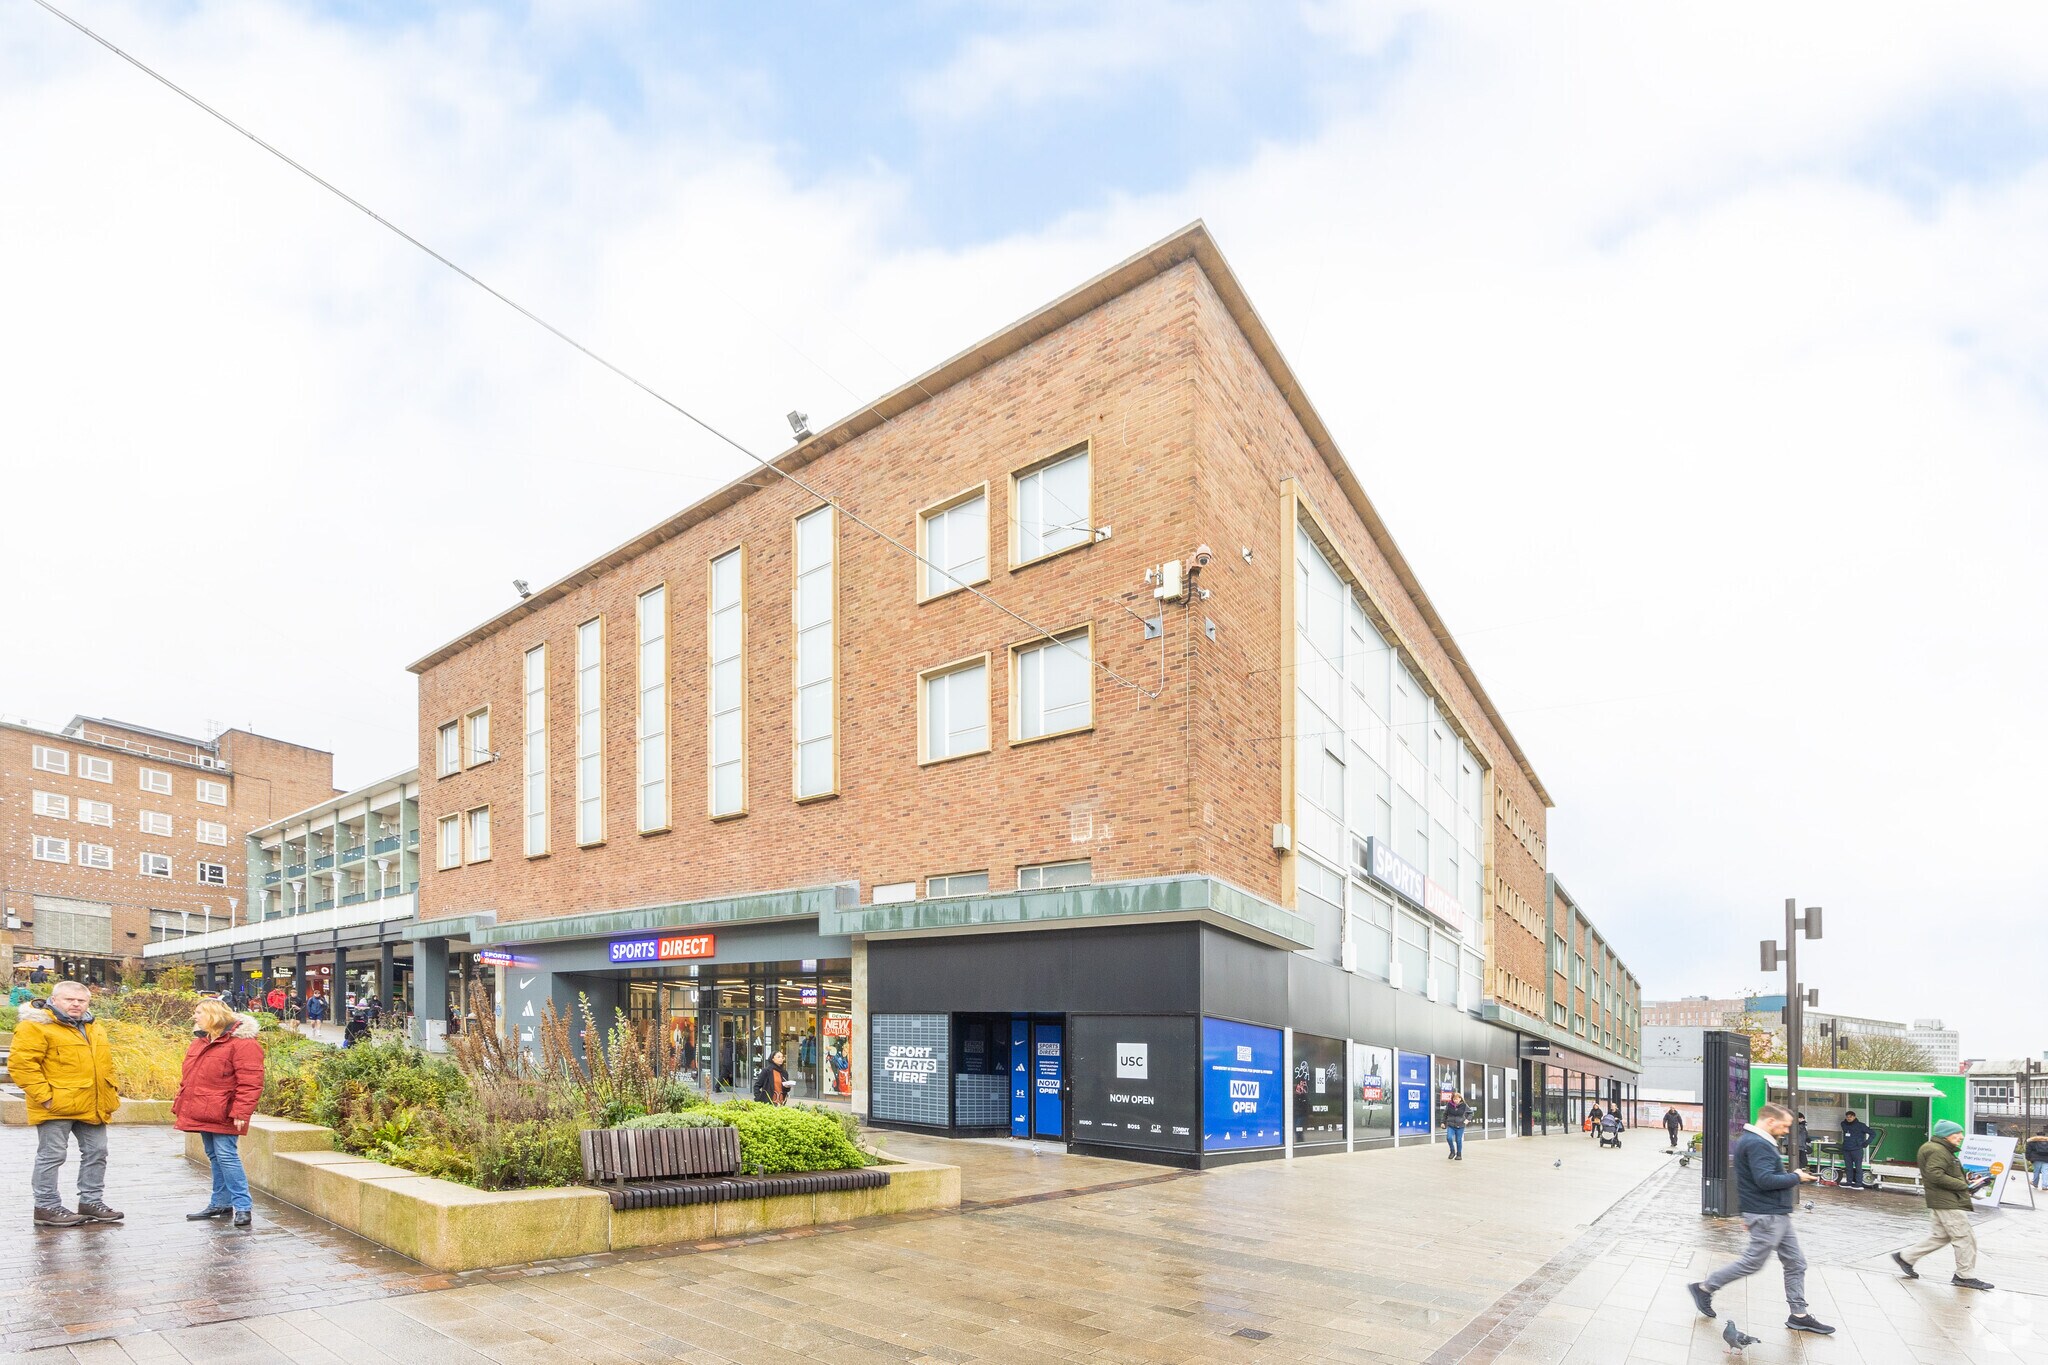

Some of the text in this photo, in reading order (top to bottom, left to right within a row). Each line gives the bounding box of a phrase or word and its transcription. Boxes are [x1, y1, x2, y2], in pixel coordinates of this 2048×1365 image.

[1376, 845, 1461, 924] SPORTS DIRECT
[612, 938, 709, 959] SPORTS DIRECT
[484, 951, 510, 959] SPORTS
[484, 958, 510, 966] DIRECT
[825, 1020, 849, 1029] NEW
[889, 1046, 932, 1057] SPORT
[886, 1059, 935, 1071] STARTS
[1120, 1056, 1143, 1067] USC
[893, 1072, 928, 1083] HERE
[1364, 1076, 1381, 1086] SPORTS
[1232, 1083, 1257, 1096] NOW
[1364, 1089, 1381, 1099] DIRECT
[1409, 1091, 1419, 1099] NOW
[1110, 1094, 1154, 1105] NOW OPEN
[1232, 1101, 1257, 1113] OPEN
